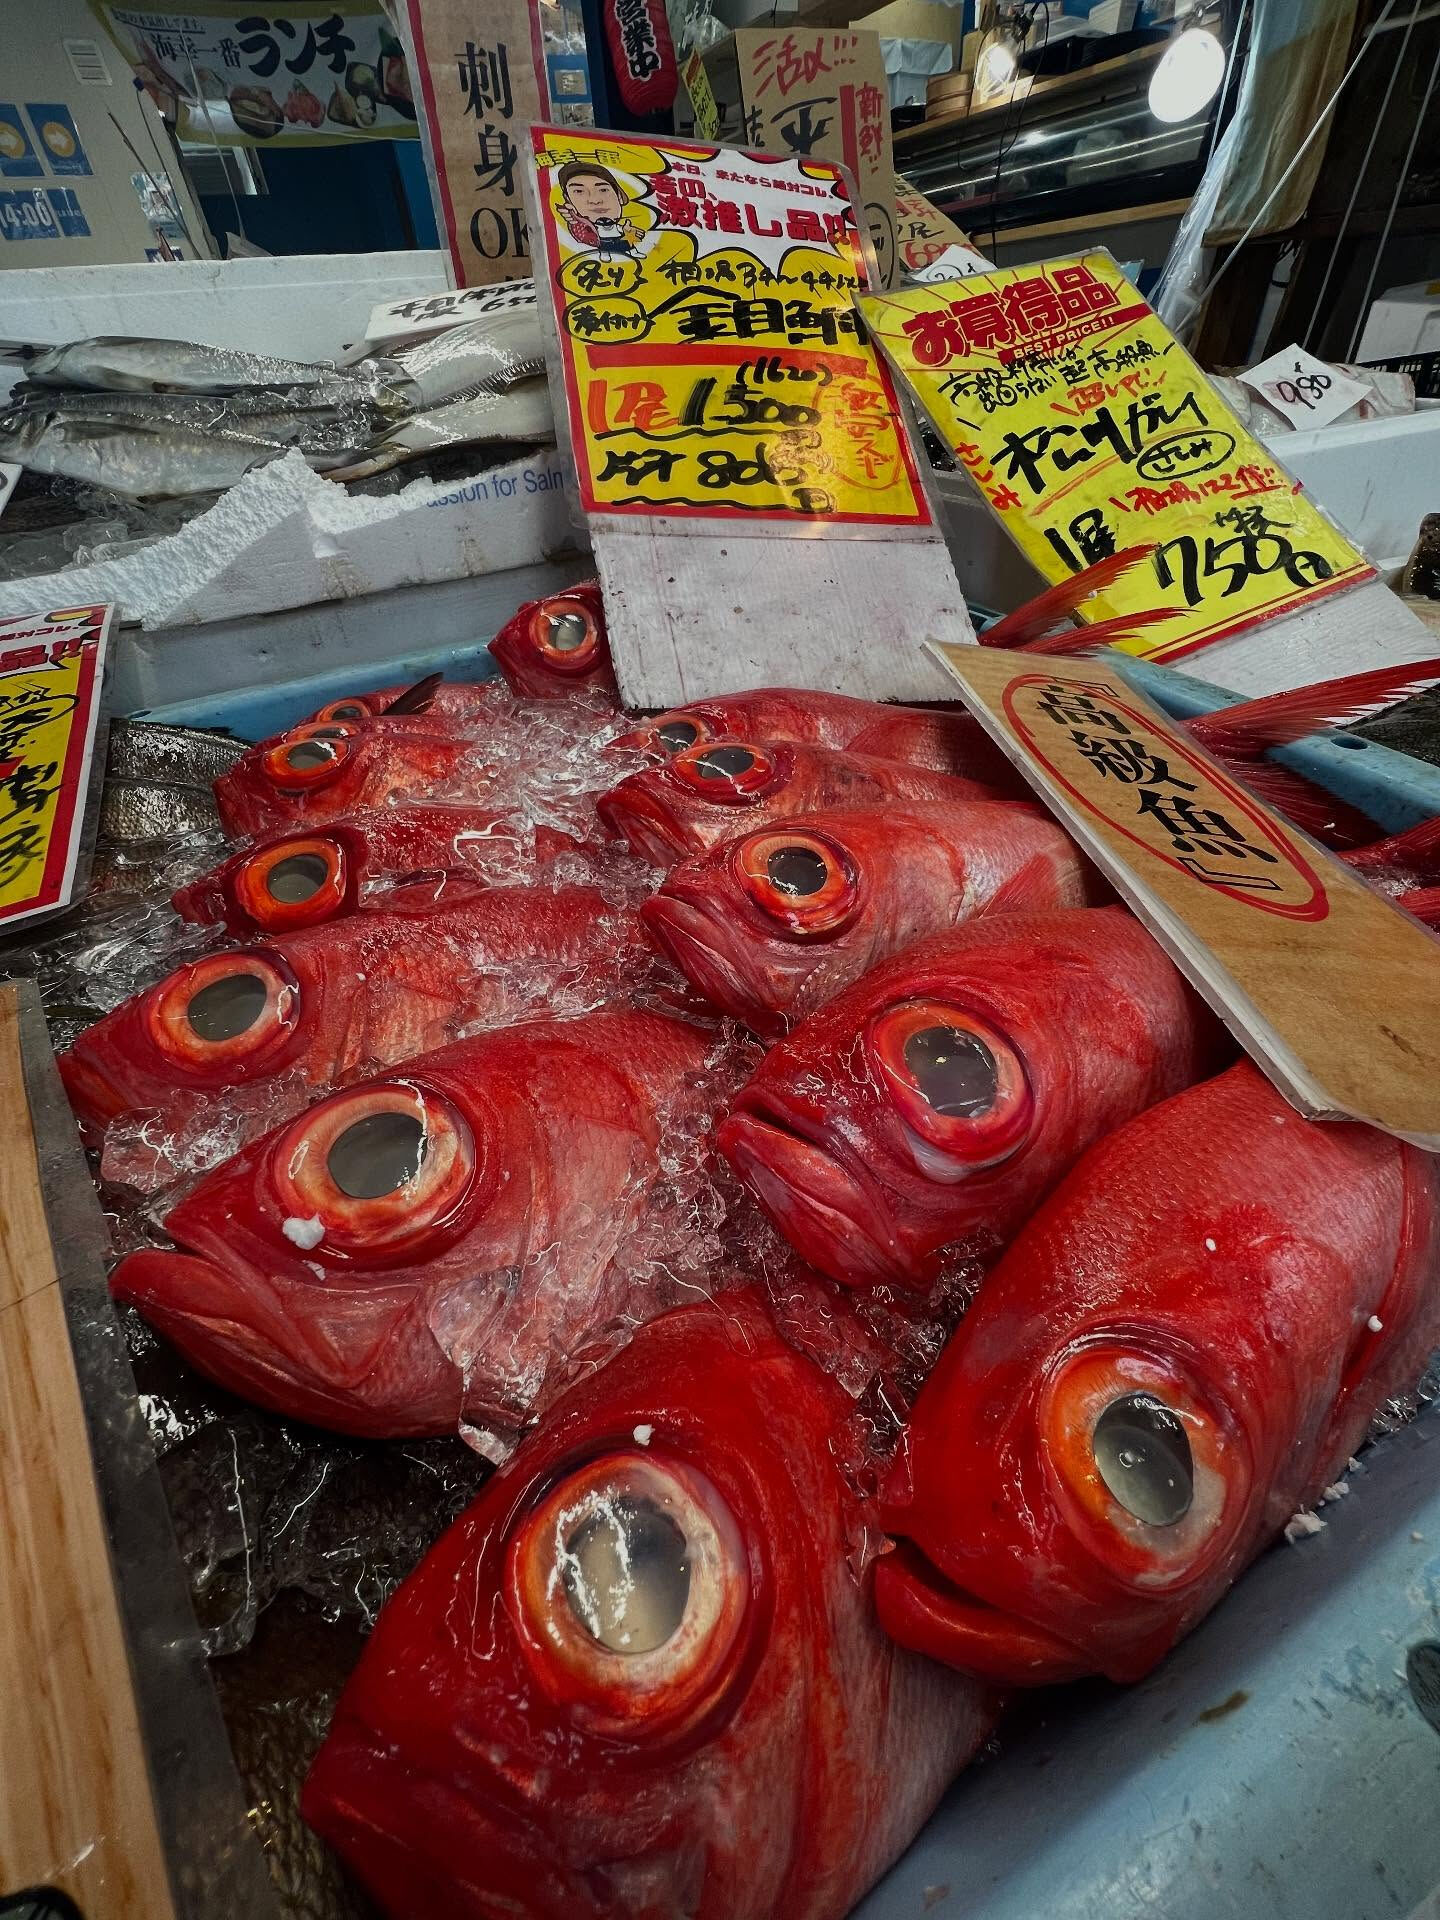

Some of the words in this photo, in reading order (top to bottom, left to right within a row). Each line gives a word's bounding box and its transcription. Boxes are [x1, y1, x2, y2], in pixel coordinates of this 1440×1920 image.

[236, 14, 356, 77] ランチ
[657, 195, 852, 245] 激推し品!!
[902, 265, 1121, 367] お買得品
[1013, 342, 1051, 359] BEST
[1056, 316, 1116, 346] PRICE!!
[493, 474, 519, 497] for
